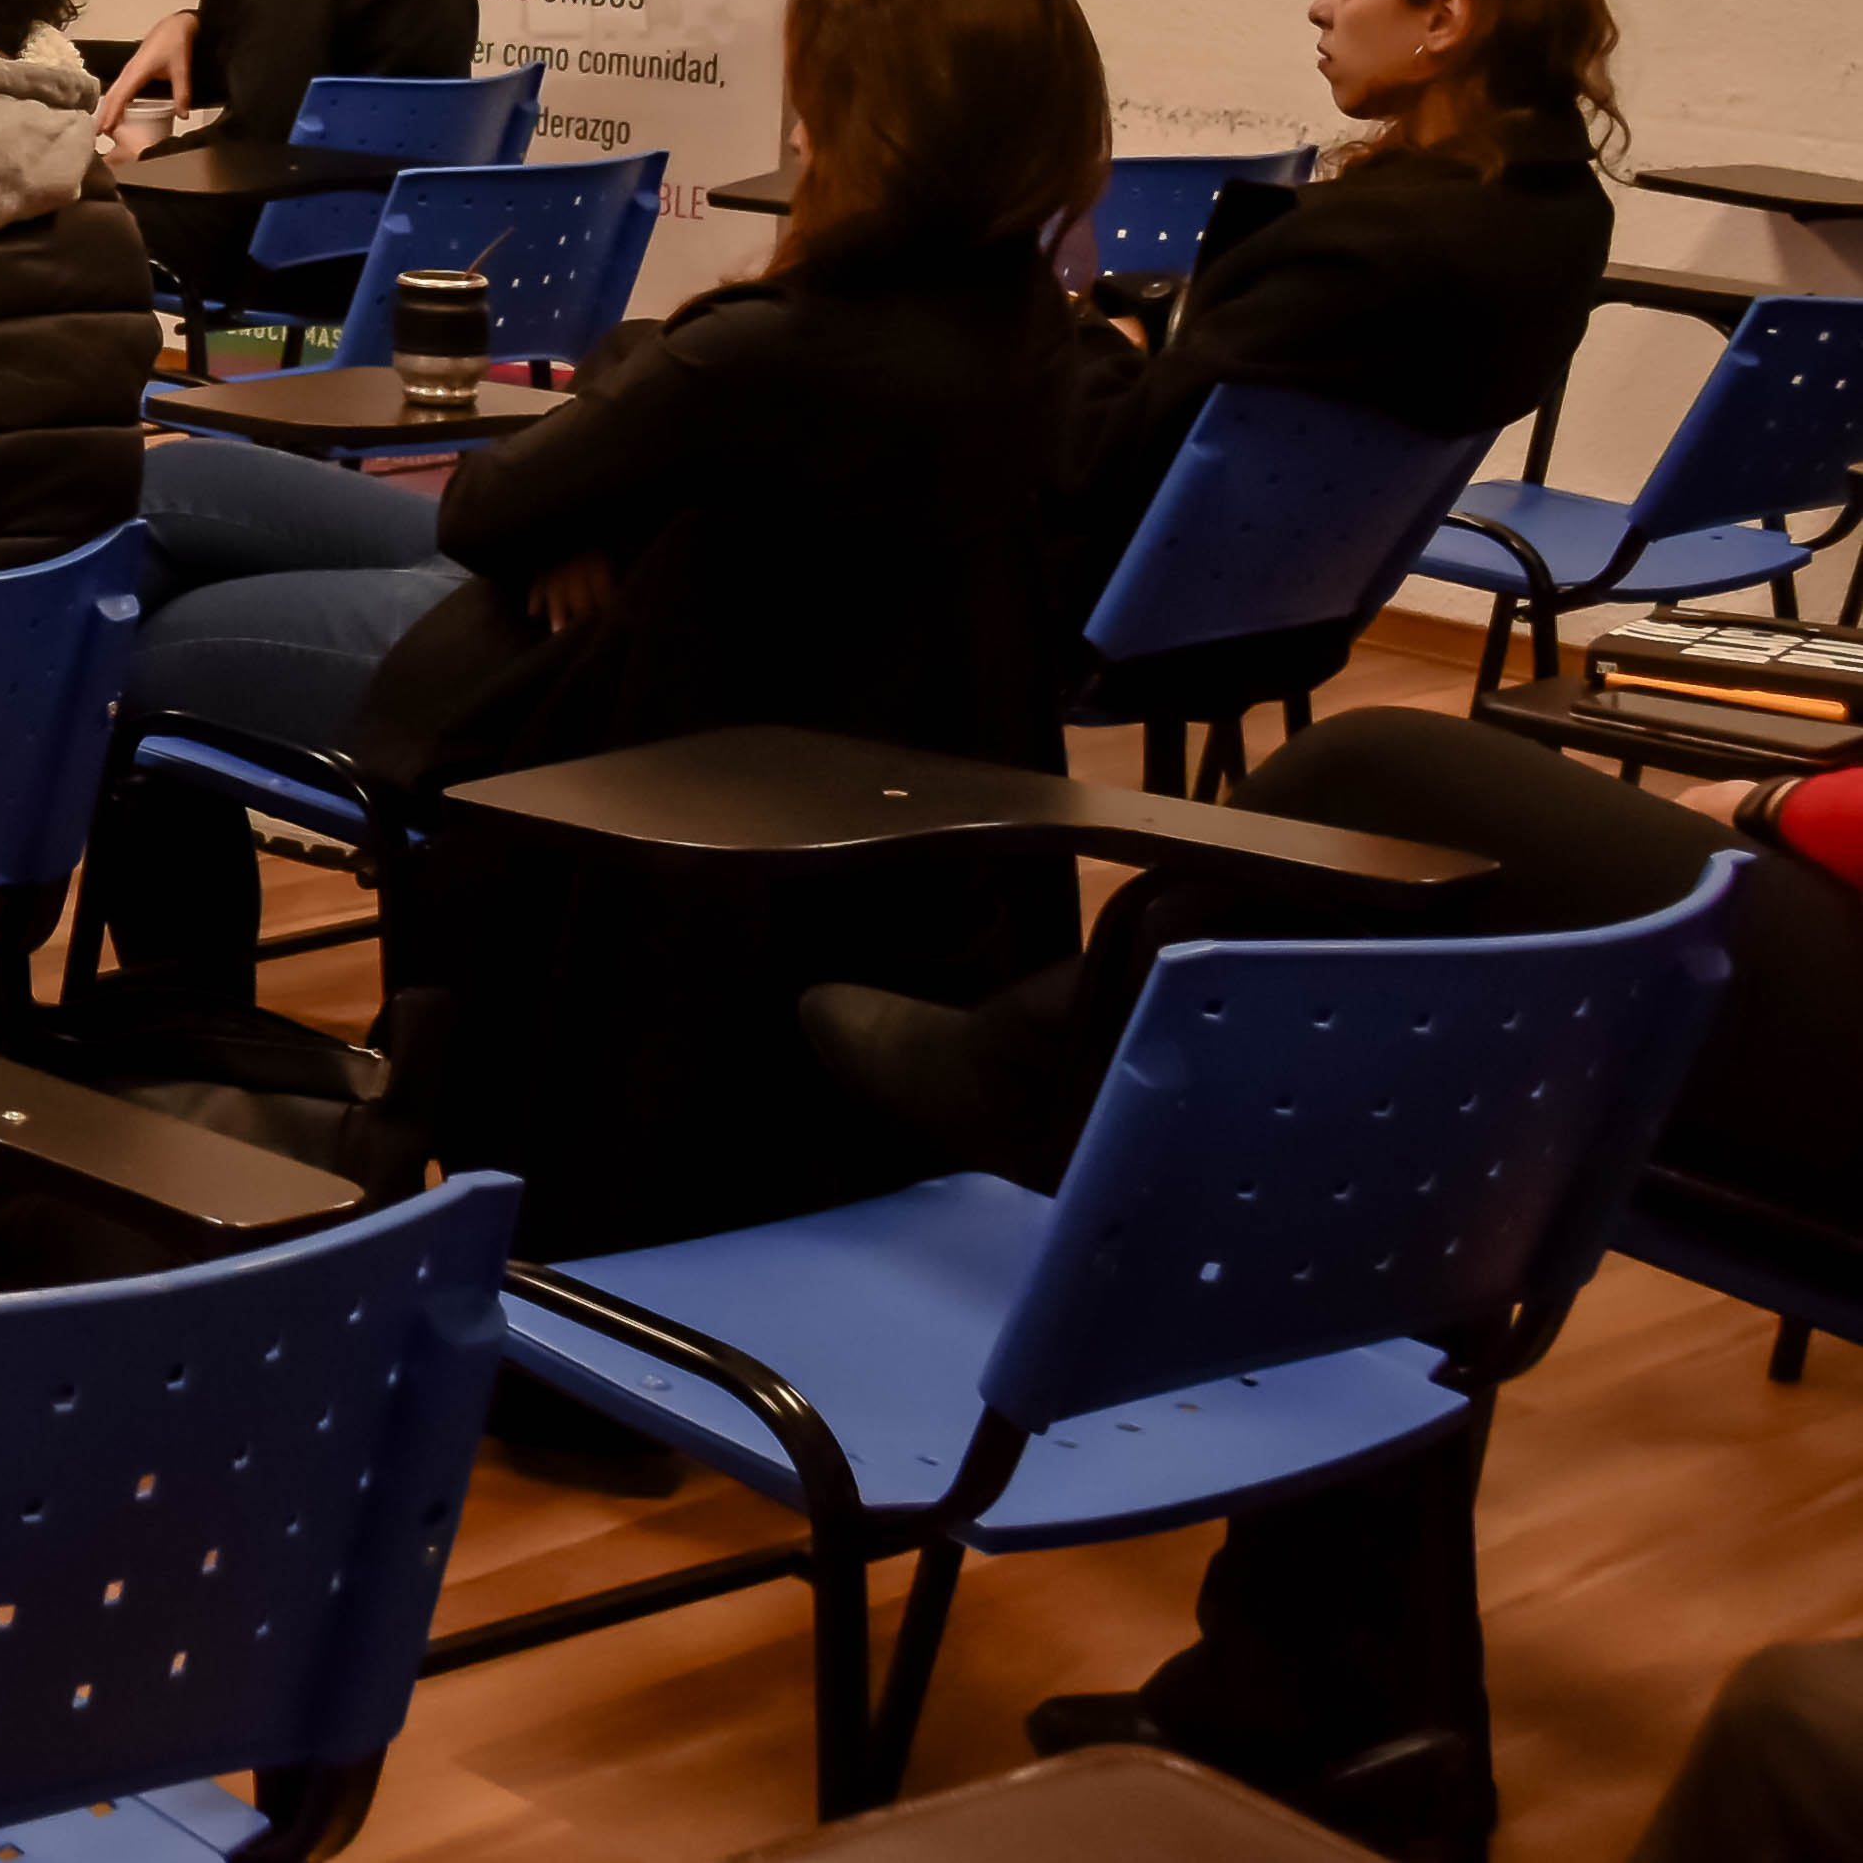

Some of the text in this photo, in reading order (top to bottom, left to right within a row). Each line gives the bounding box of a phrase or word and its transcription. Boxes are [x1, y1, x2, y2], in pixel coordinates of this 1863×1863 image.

[503, 42, 569, 72] como
[578, 49, 725, 88] comunidad,
[536, 106, 631, 151] derazgo
